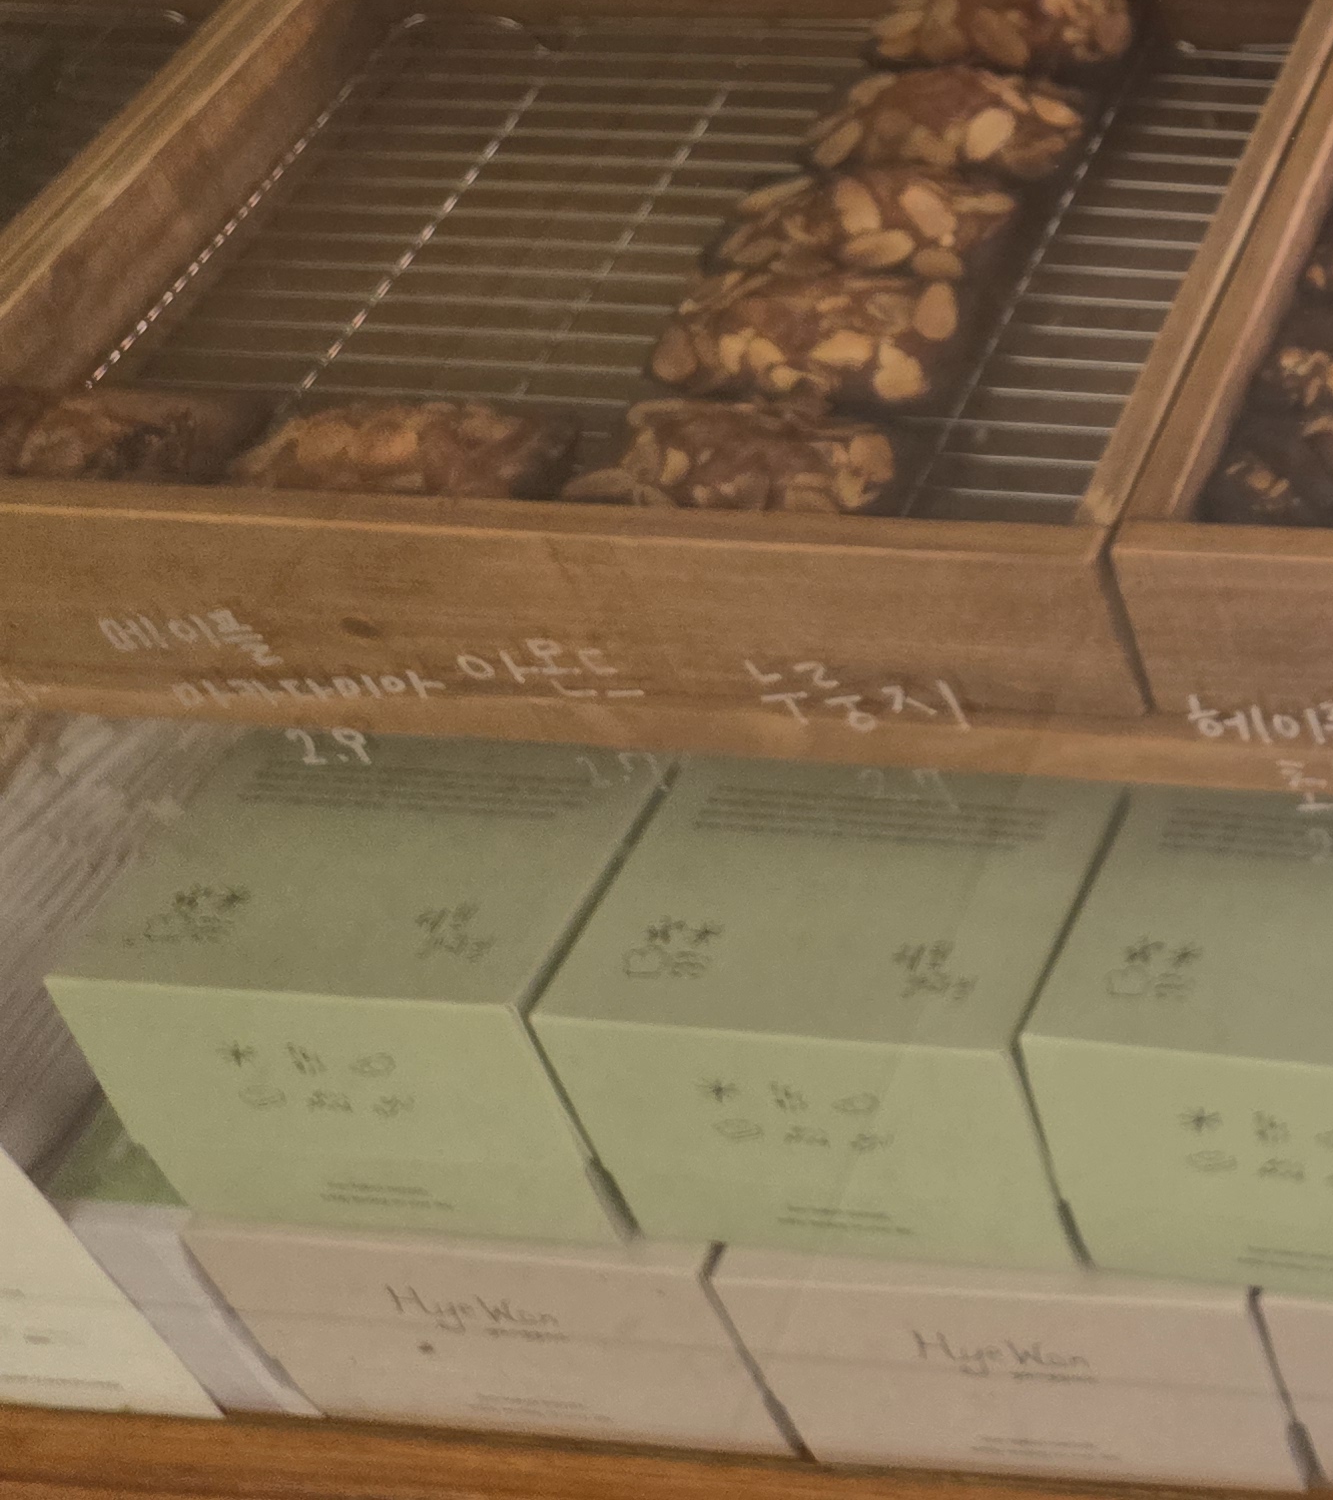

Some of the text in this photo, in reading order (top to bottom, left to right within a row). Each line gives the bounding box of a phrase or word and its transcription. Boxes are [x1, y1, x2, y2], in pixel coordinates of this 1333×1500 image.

[99, 607, 282, 666] 메이플
[456, 637, 646, 697] 아몬드
[743, 659, 972, 732] 누룽지
[285, 727, 371, 765] 2.9
